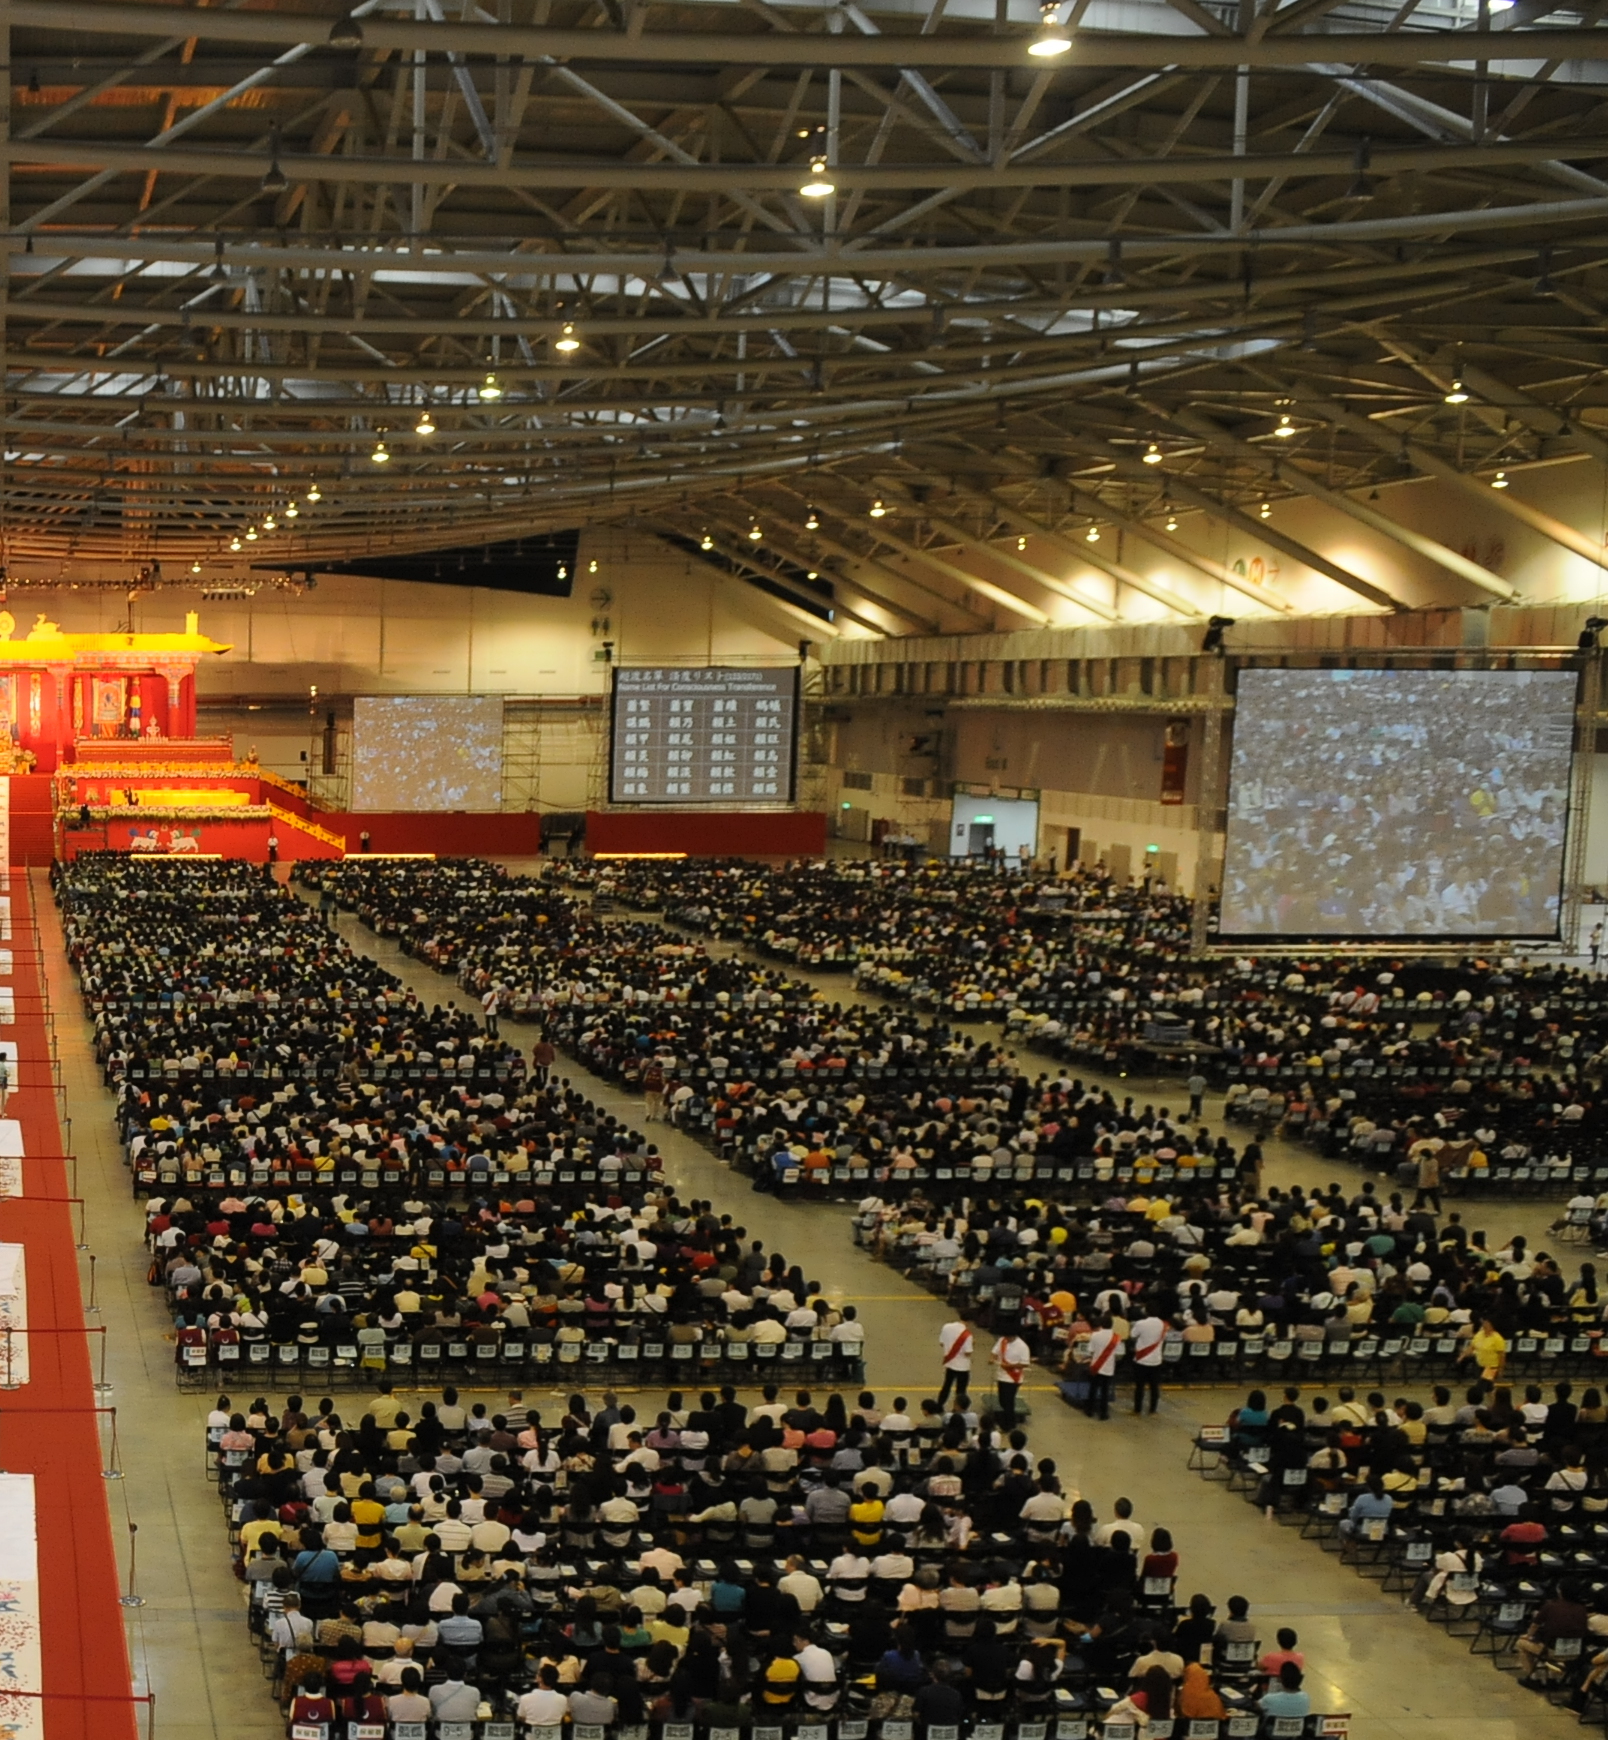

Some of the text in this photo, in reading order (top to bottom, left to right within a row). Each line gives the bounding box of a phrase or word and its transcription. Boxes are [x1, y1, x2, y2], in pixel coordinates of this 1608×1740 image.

[671, 683, 726, 691] Consciousness
[728, 683, 776, 691] Transference
[886, 1723, 904, 1734] 9-5
[1061, 1724, 1079, 1735] 9-5
[1150, 1723, 1167, 1733] 9-5
[1232, 1721, 1251, 1730] 9-5
[442, 1725, 463, 1737] 9-5
[535, 1729, 553, 1739] 9-5
[800, 1728, 818, 1738] 9-5
[978, 1727, 995, 1737] 9-5
